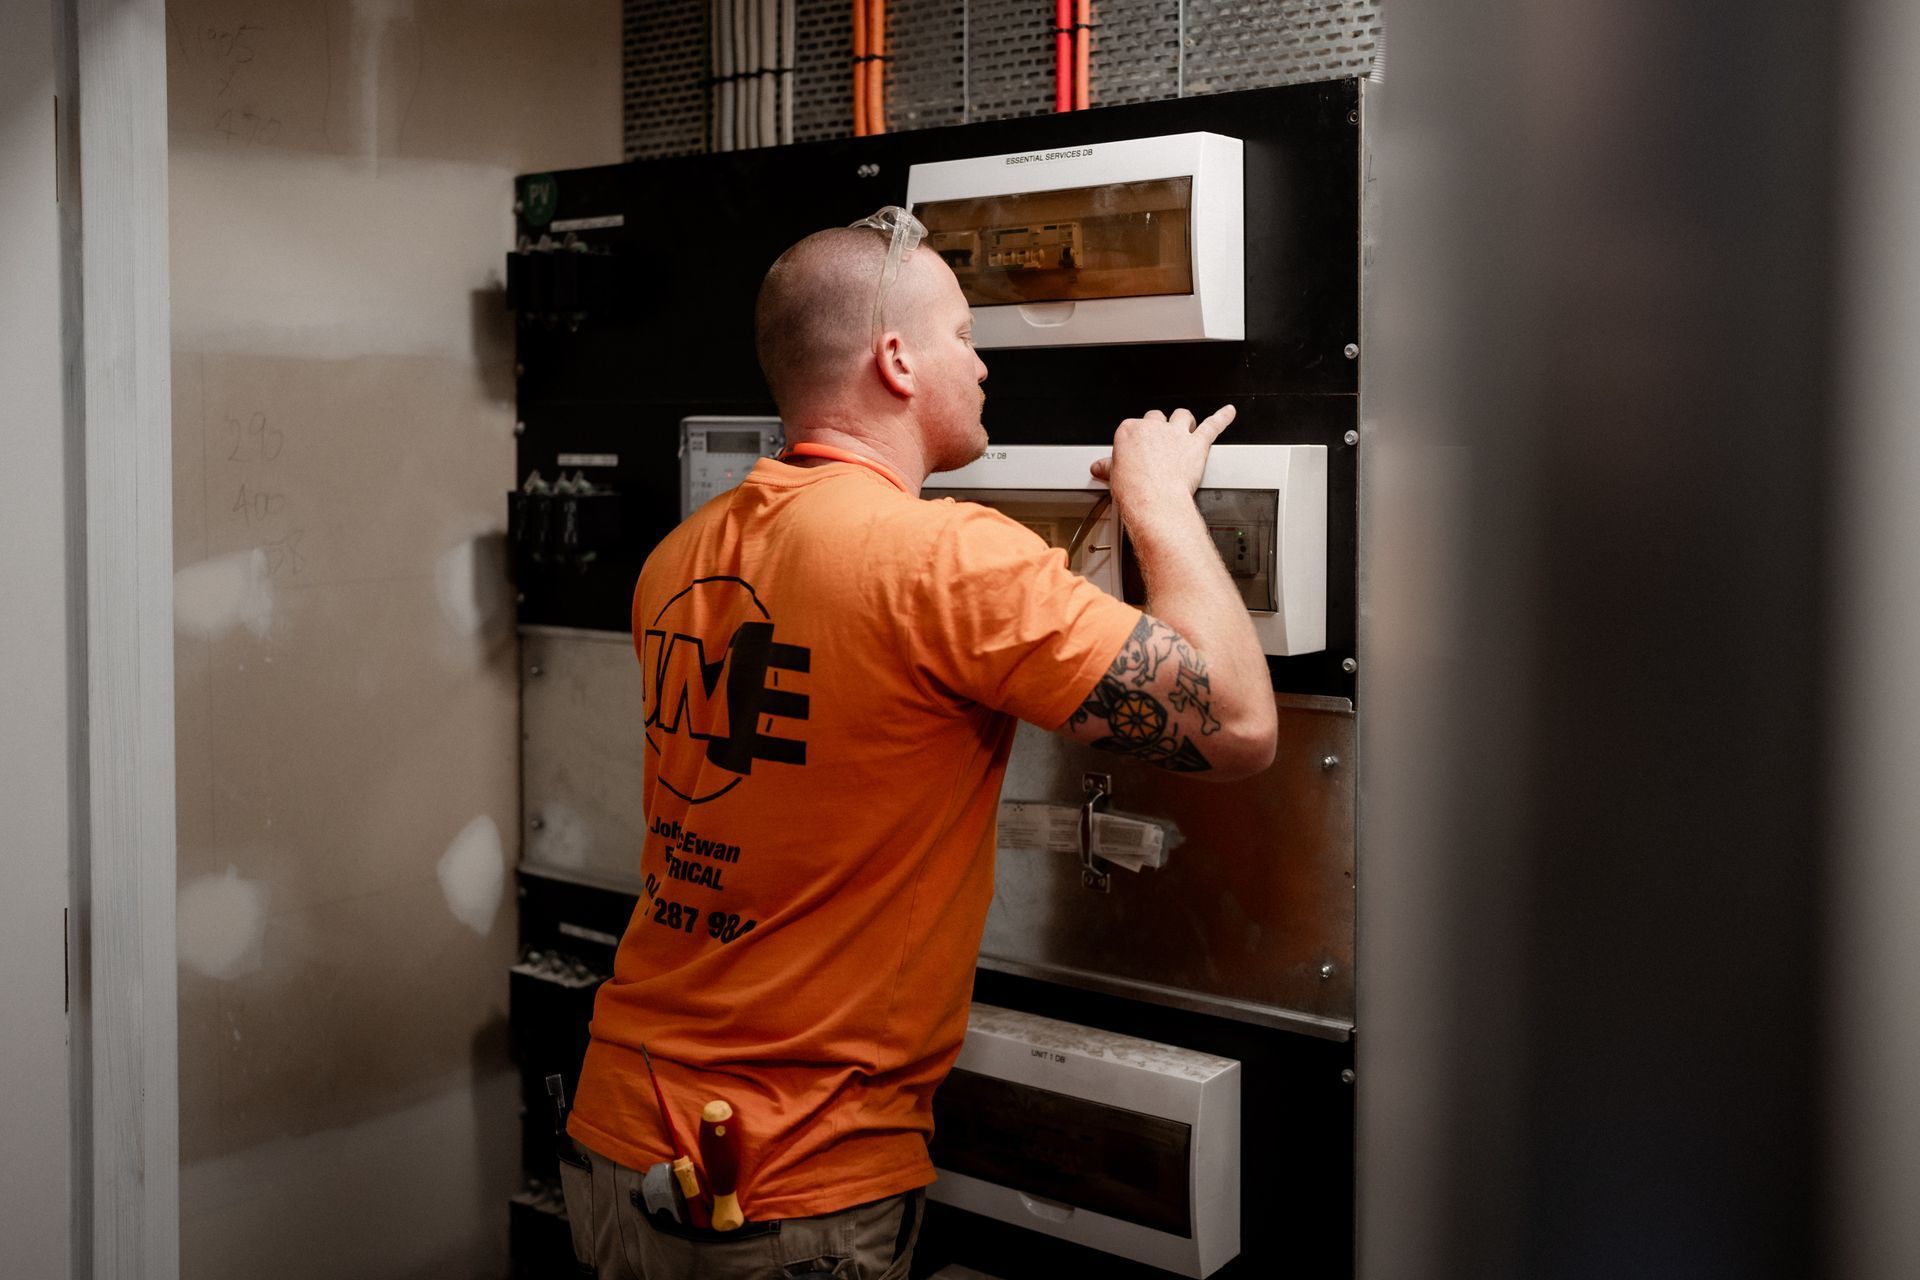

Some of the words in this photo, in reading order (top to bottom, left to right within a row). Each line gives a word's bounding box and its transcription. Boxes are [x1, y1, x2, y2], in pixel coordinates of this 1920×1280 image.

[1006, 155, 1043, 165] ESSENTIAL
[1045, 150, 1081, 160] SERVICES
[1082, 148, 1093, 156] DB
[653, 897, 699, 933] 287
[1031, 1049, 1048, 1059] UNIT
[1055, 1055, 1066, 1063] DB
